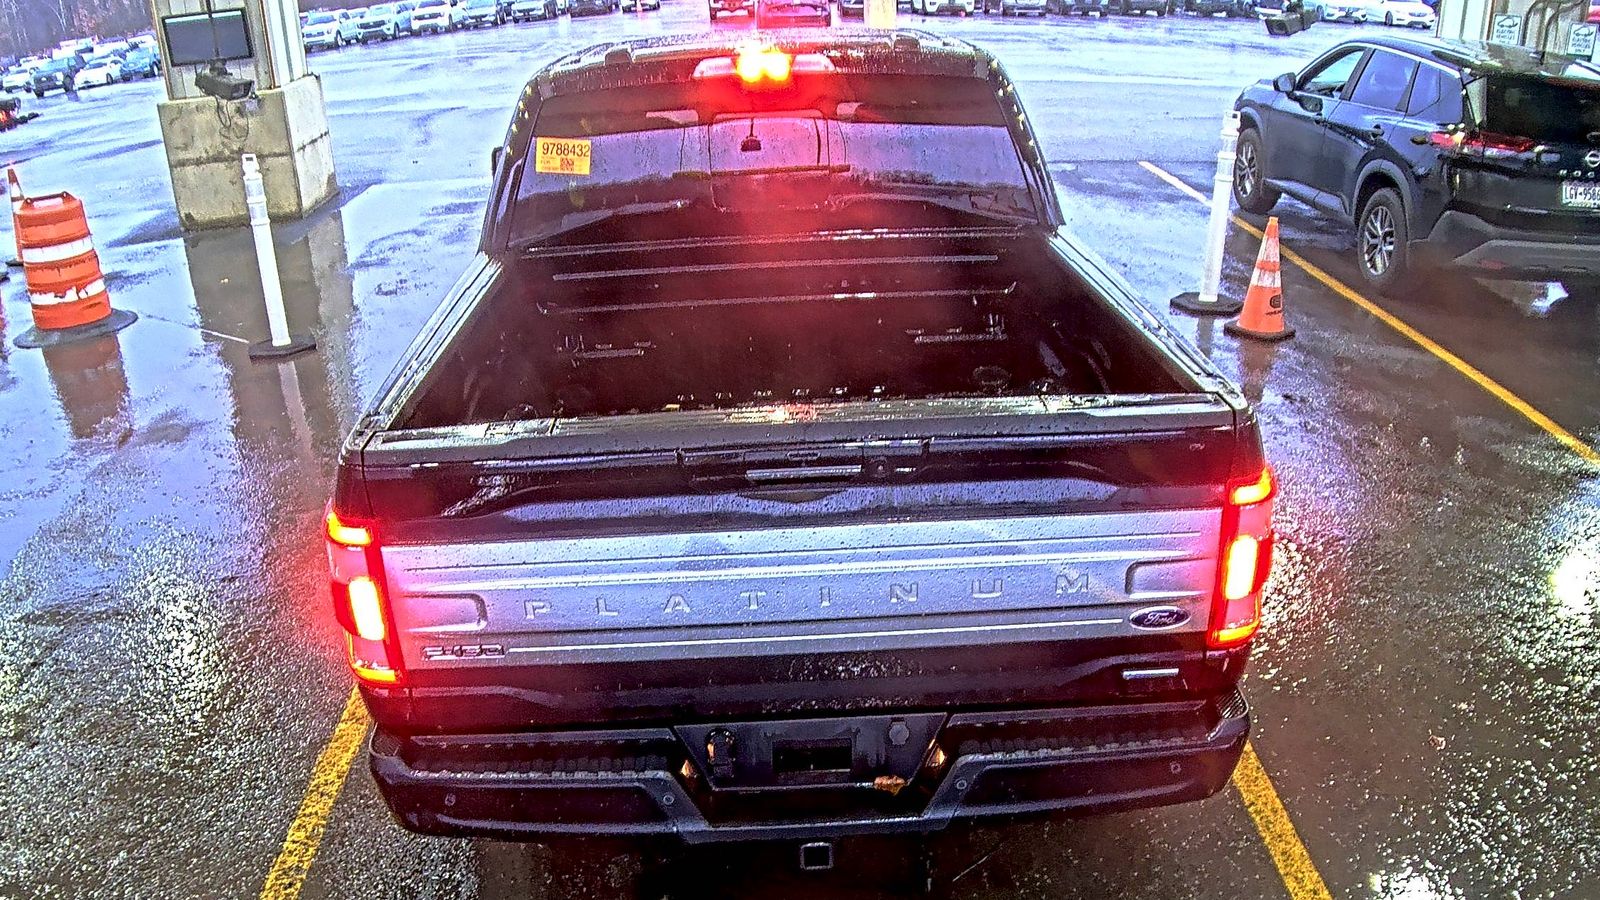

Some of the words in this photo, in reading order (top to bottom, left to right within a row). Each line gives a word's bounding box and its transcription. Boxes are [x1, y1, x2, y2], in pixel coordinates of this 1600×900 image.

[542, 142, 590, 157] 9788432
[523, 572, 1091, 620] PLATINUM
[1143, 611, 1177, 625] Ford
[422, 644, 505, 661] F-150
